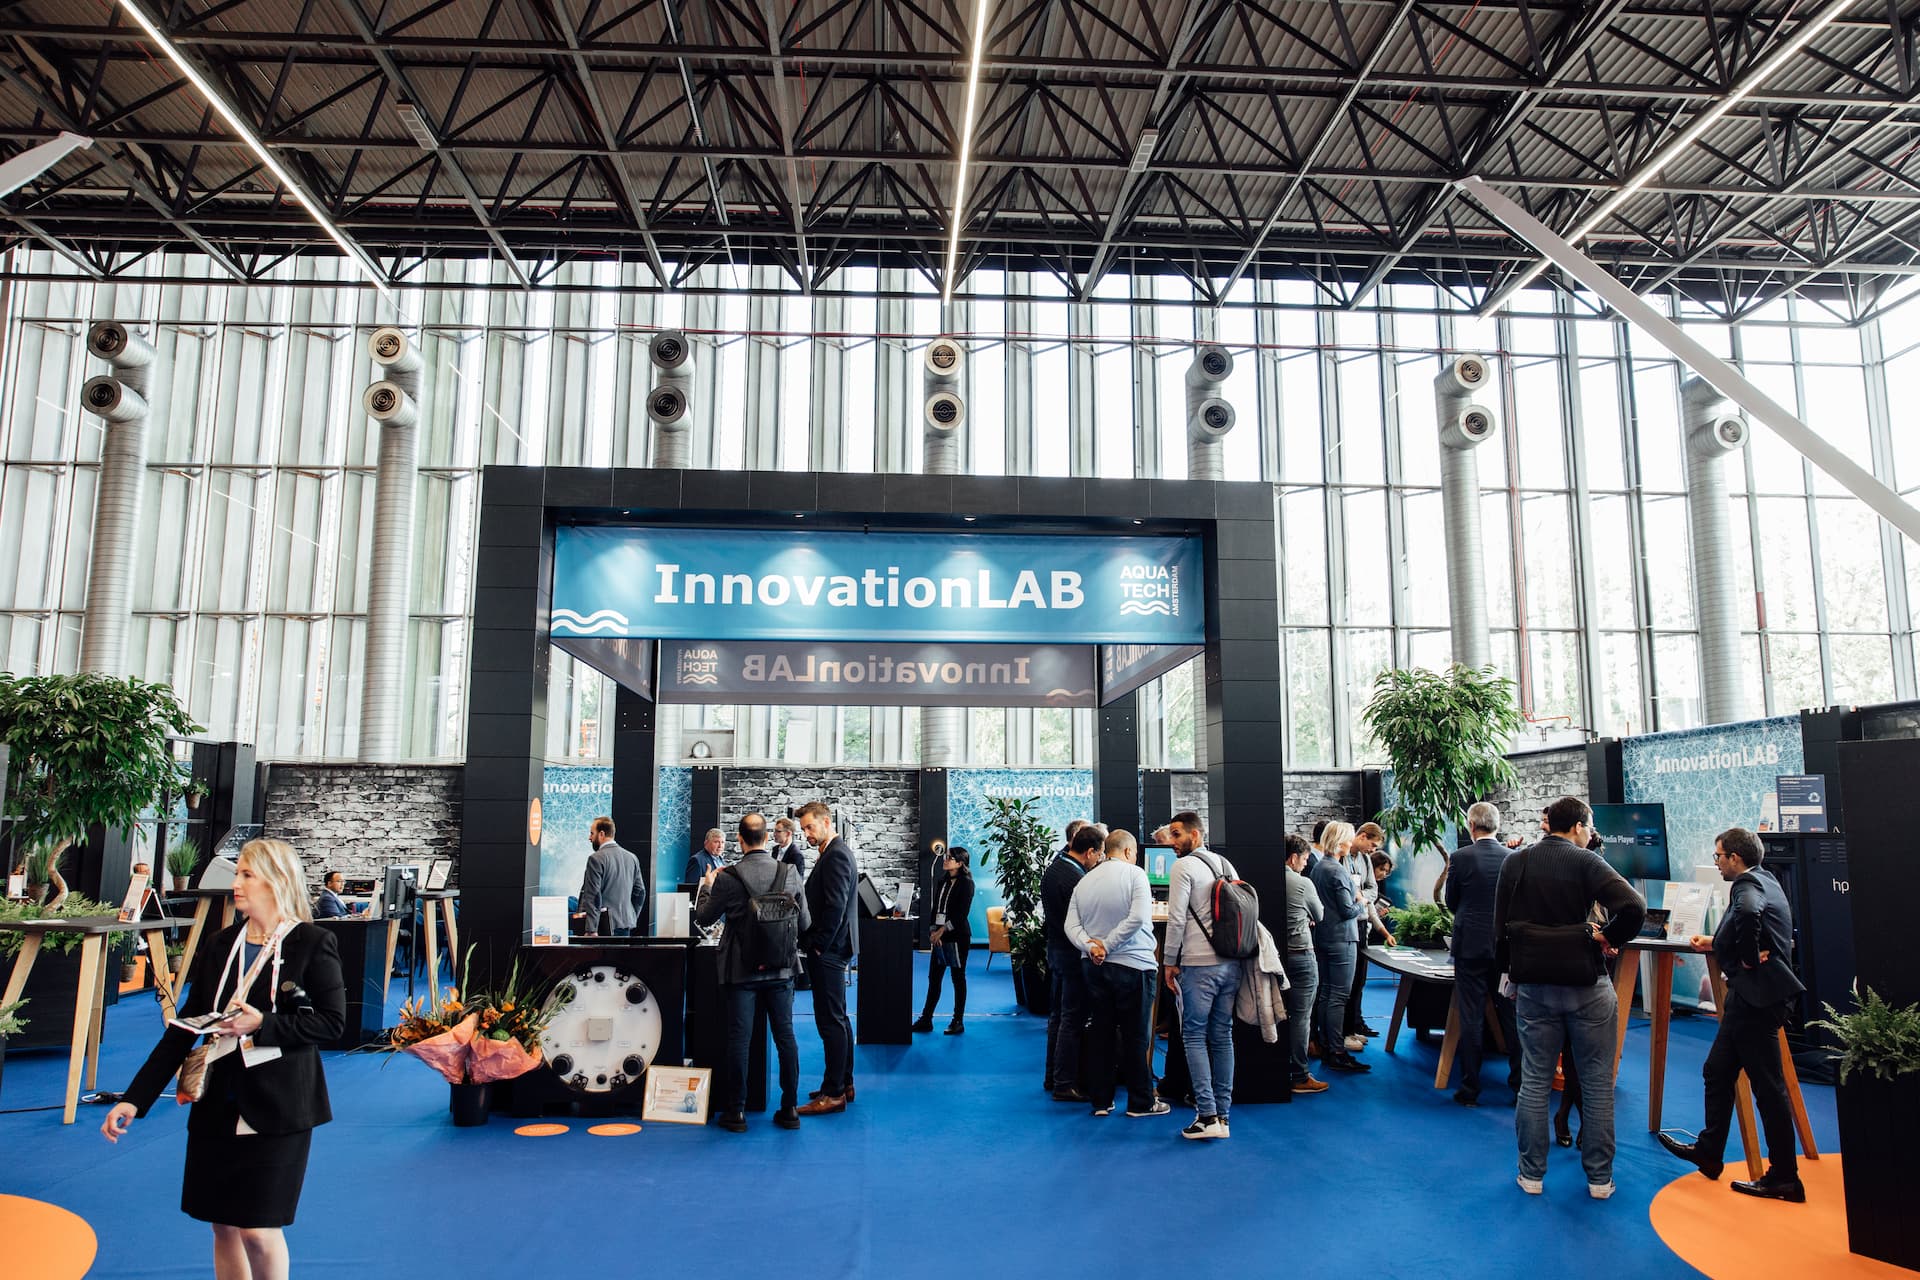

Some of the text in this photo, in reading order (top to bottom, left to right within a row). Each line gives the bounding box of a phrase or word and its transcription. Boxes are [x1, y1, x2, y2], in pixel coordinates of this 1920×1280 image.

[1120, 565, 1169, 580] AQUA
[653, 563, 1085, 609] InnovationLAB
[1120, 583, 1170, 598] TECH
[1171, 565, 1179, 617] AMSTERDAM
[1654, 743, 1779, 773] InnovationLAB
[543, 781, 612, 794] nnovatio
[984, 783, 1093, 797] InnovationLA
[1832, 878, 1850, 894] hp
